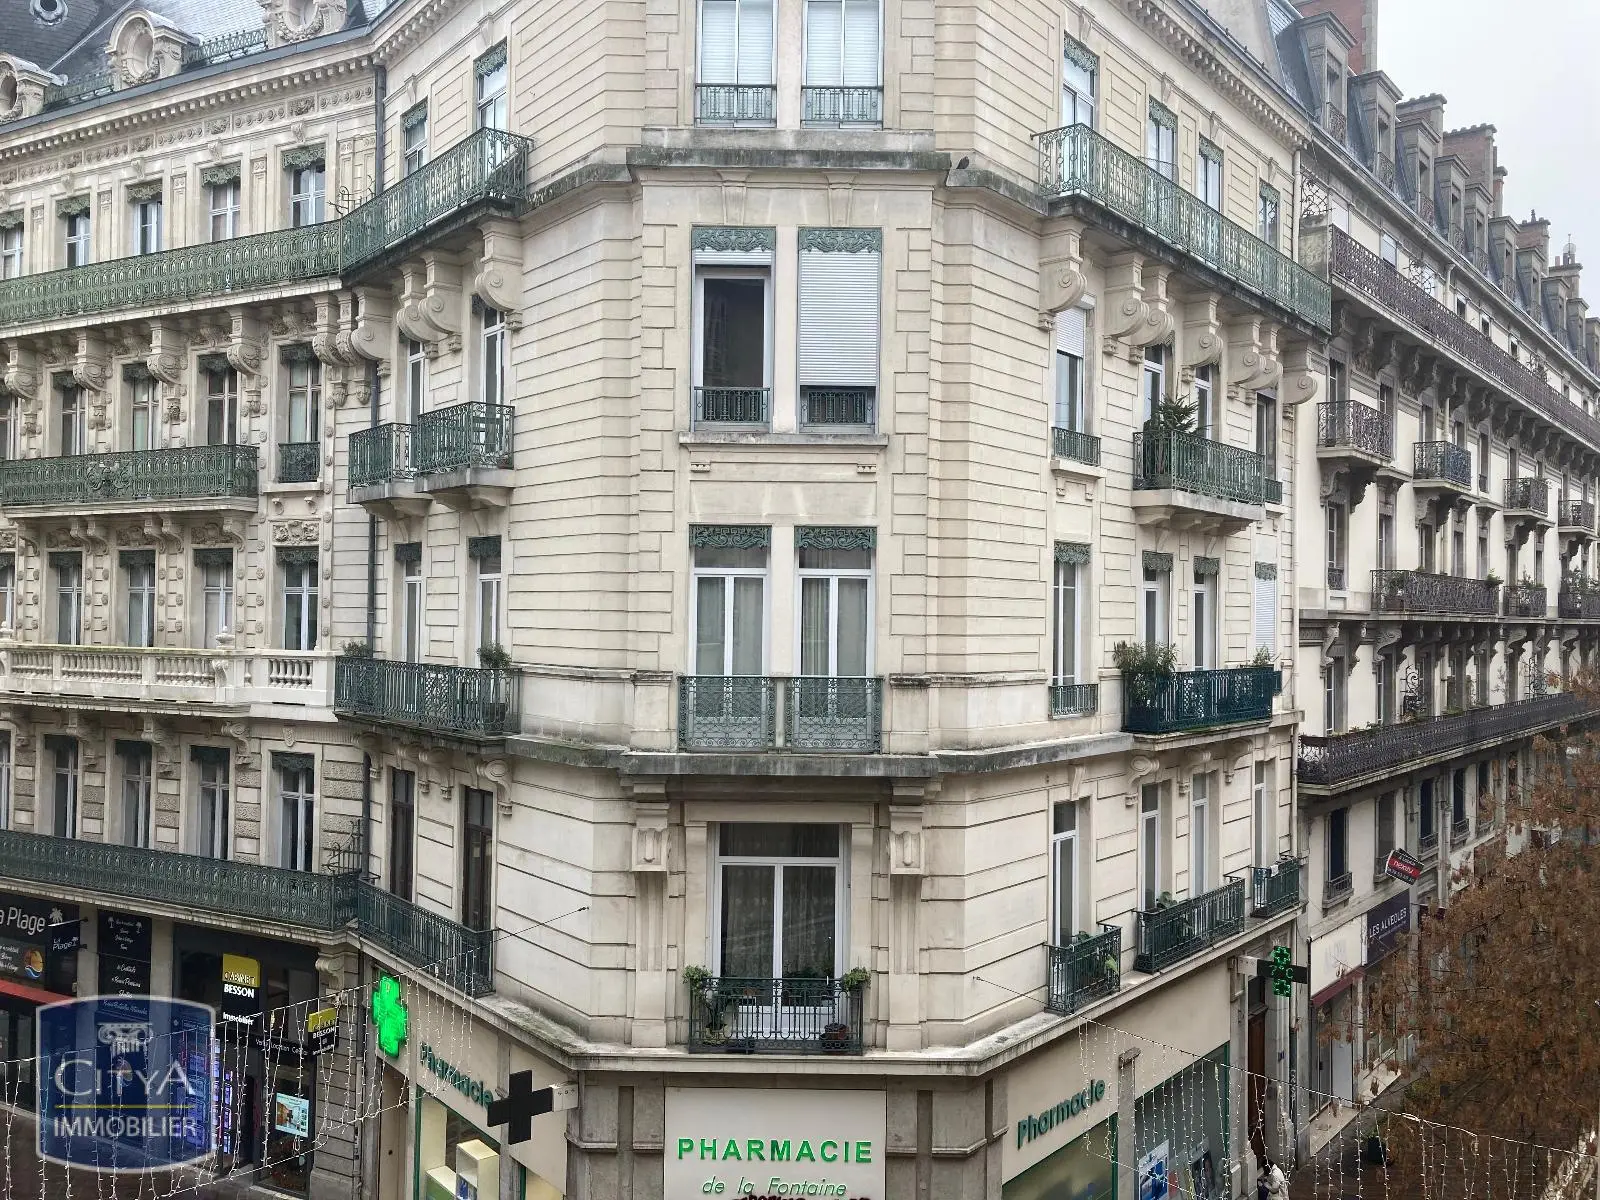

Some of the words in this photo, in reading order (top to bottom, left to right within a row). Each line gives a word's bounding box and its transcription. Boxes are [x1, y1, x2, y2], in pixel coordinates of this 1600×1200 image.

[7, 906, 46, 936] Plage
[1369, 923, 1380, 938] LES
[223, 984, 255, 999] BESSON
[312, 1026, 335, 1039] BESSON
[420, 1040, 494, 1110] Pharmacie
[1017, 1079, 1106, 1151] Pharmacie
[677, 1137, 873, 1164] PHARMACIE
[702, 1176, 725, 1195] de
[737, 1176, 755, 1195] la
[767, 1177, 848, 1196] Fontaine
